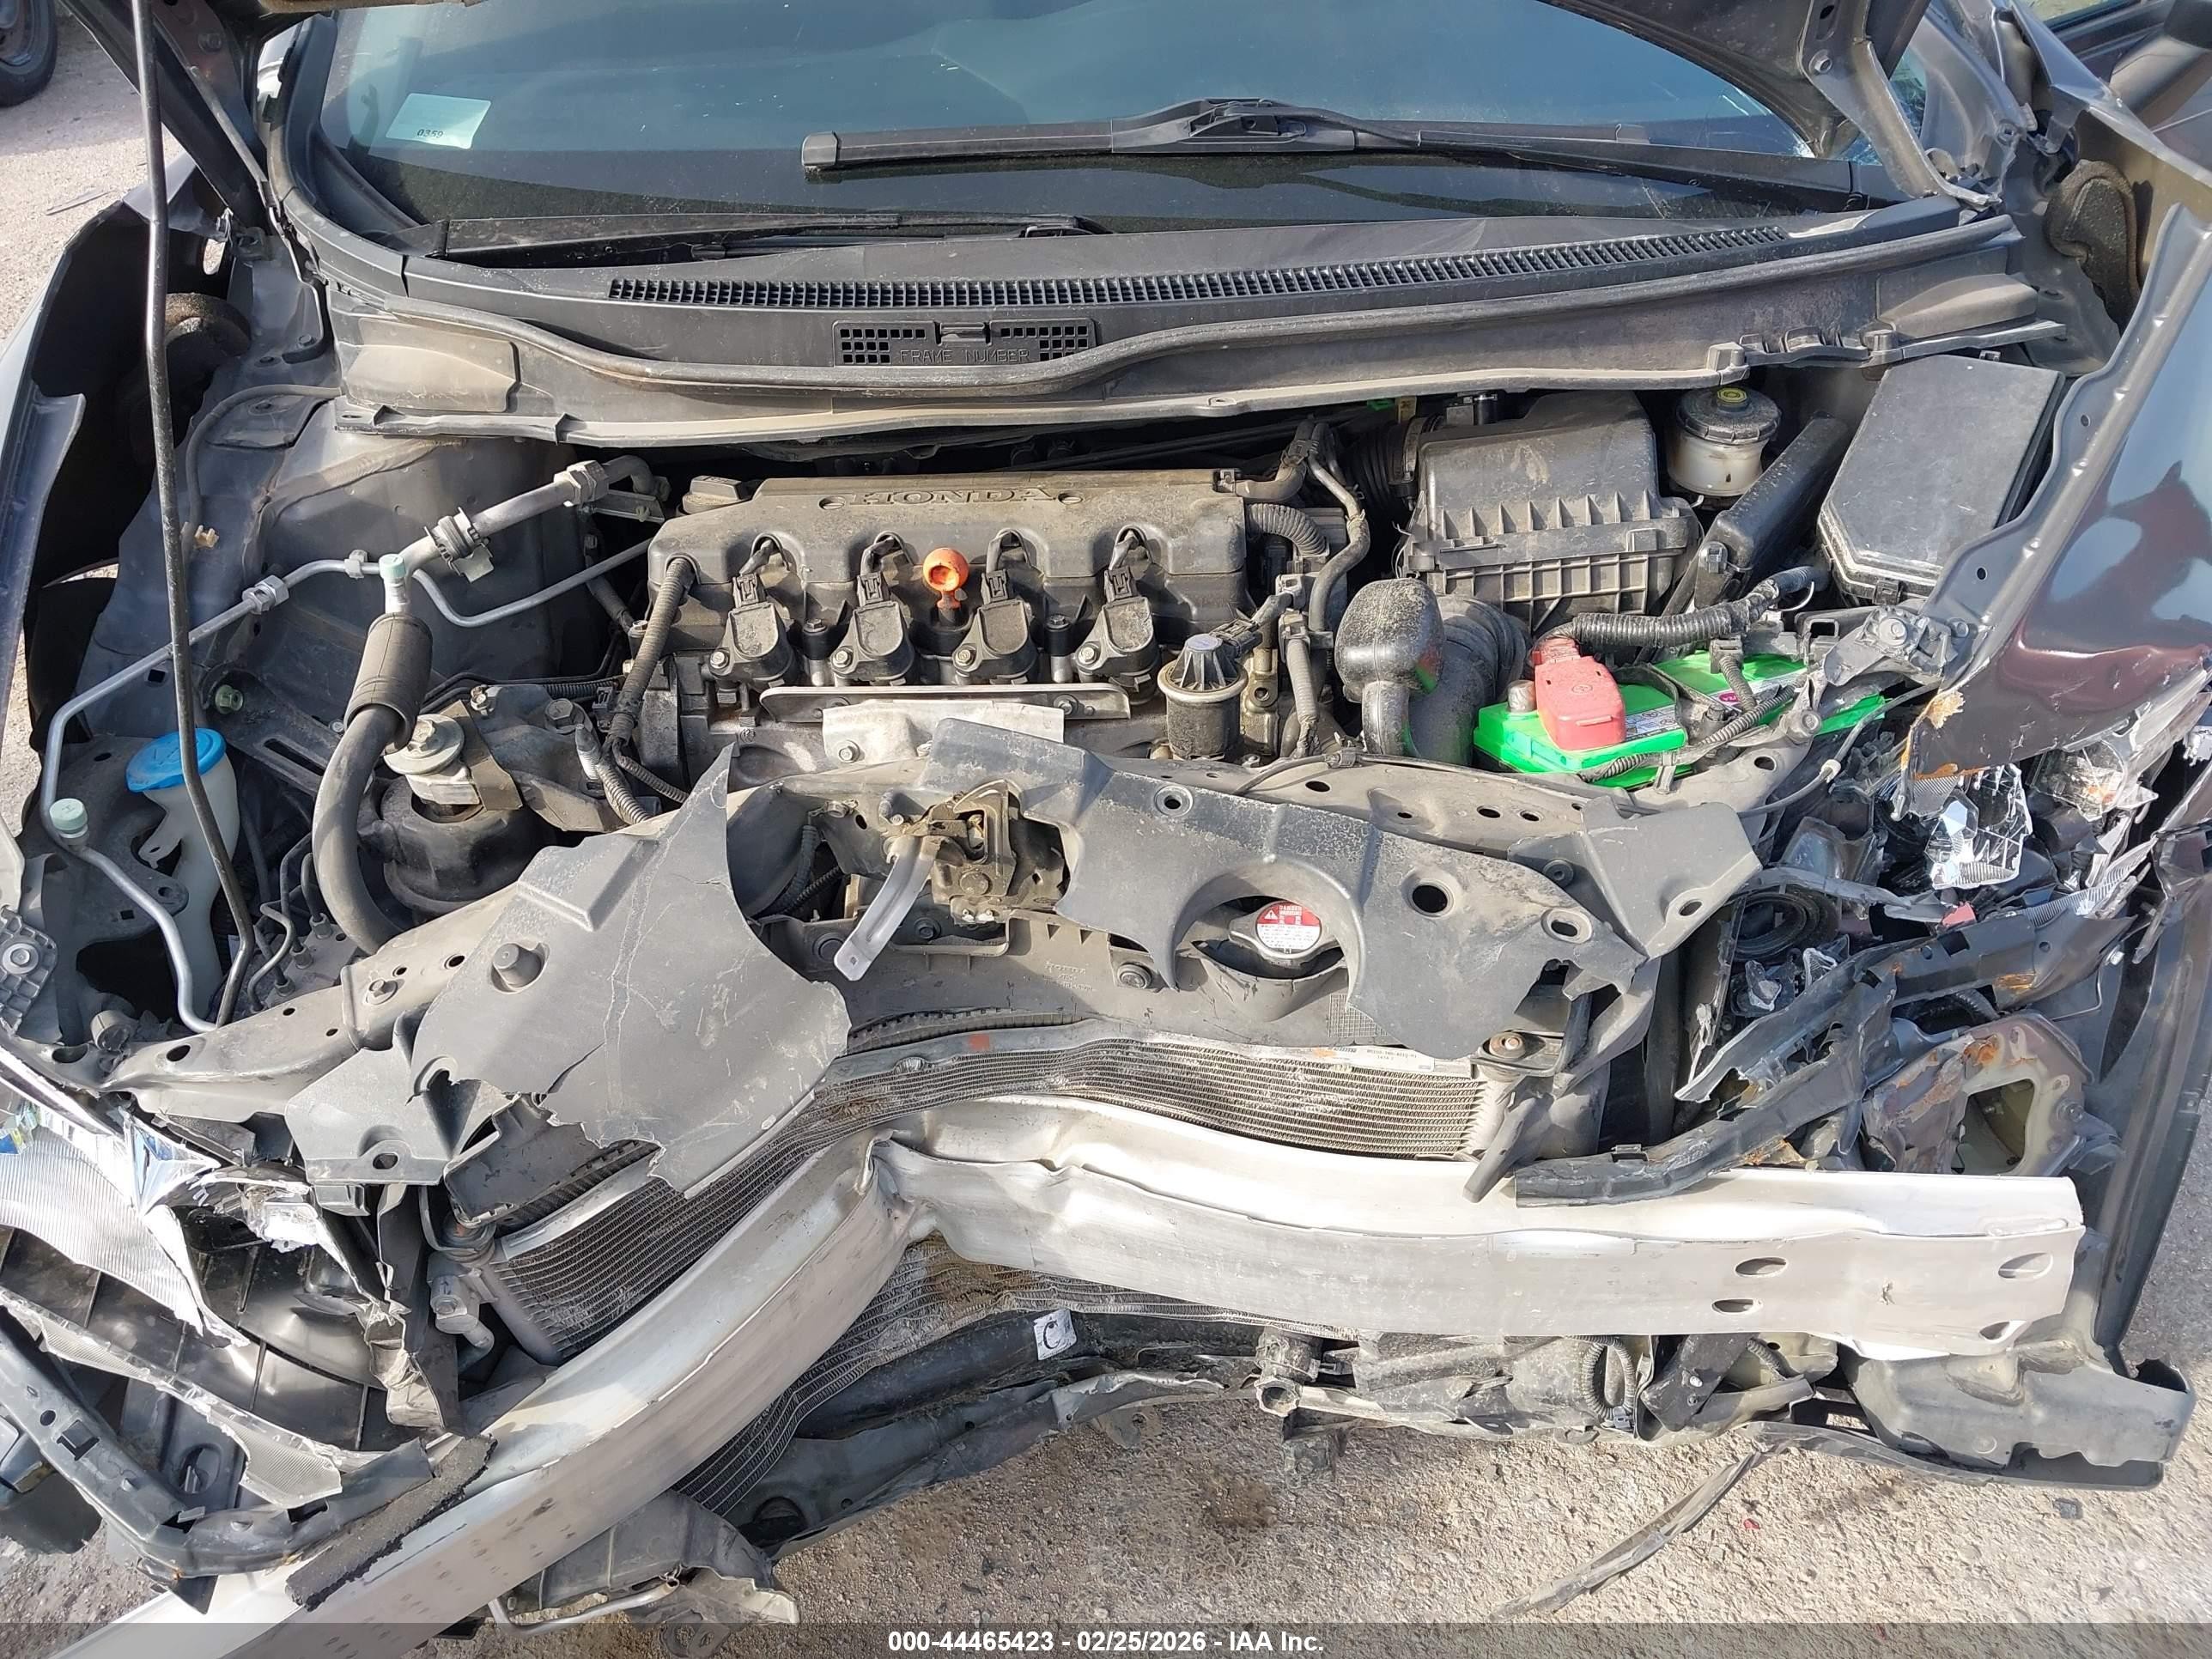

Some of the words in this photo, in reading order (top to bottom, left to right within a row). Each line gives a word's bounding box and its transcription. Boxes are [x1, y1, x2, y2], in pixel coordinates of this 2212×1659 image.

[416, 129, 444, 138] 0359
[901, 349, 952, 362] FRAME
[965, 349, 1030, 363] NUMBER
[850, 487, 1057, 505] HONDA
